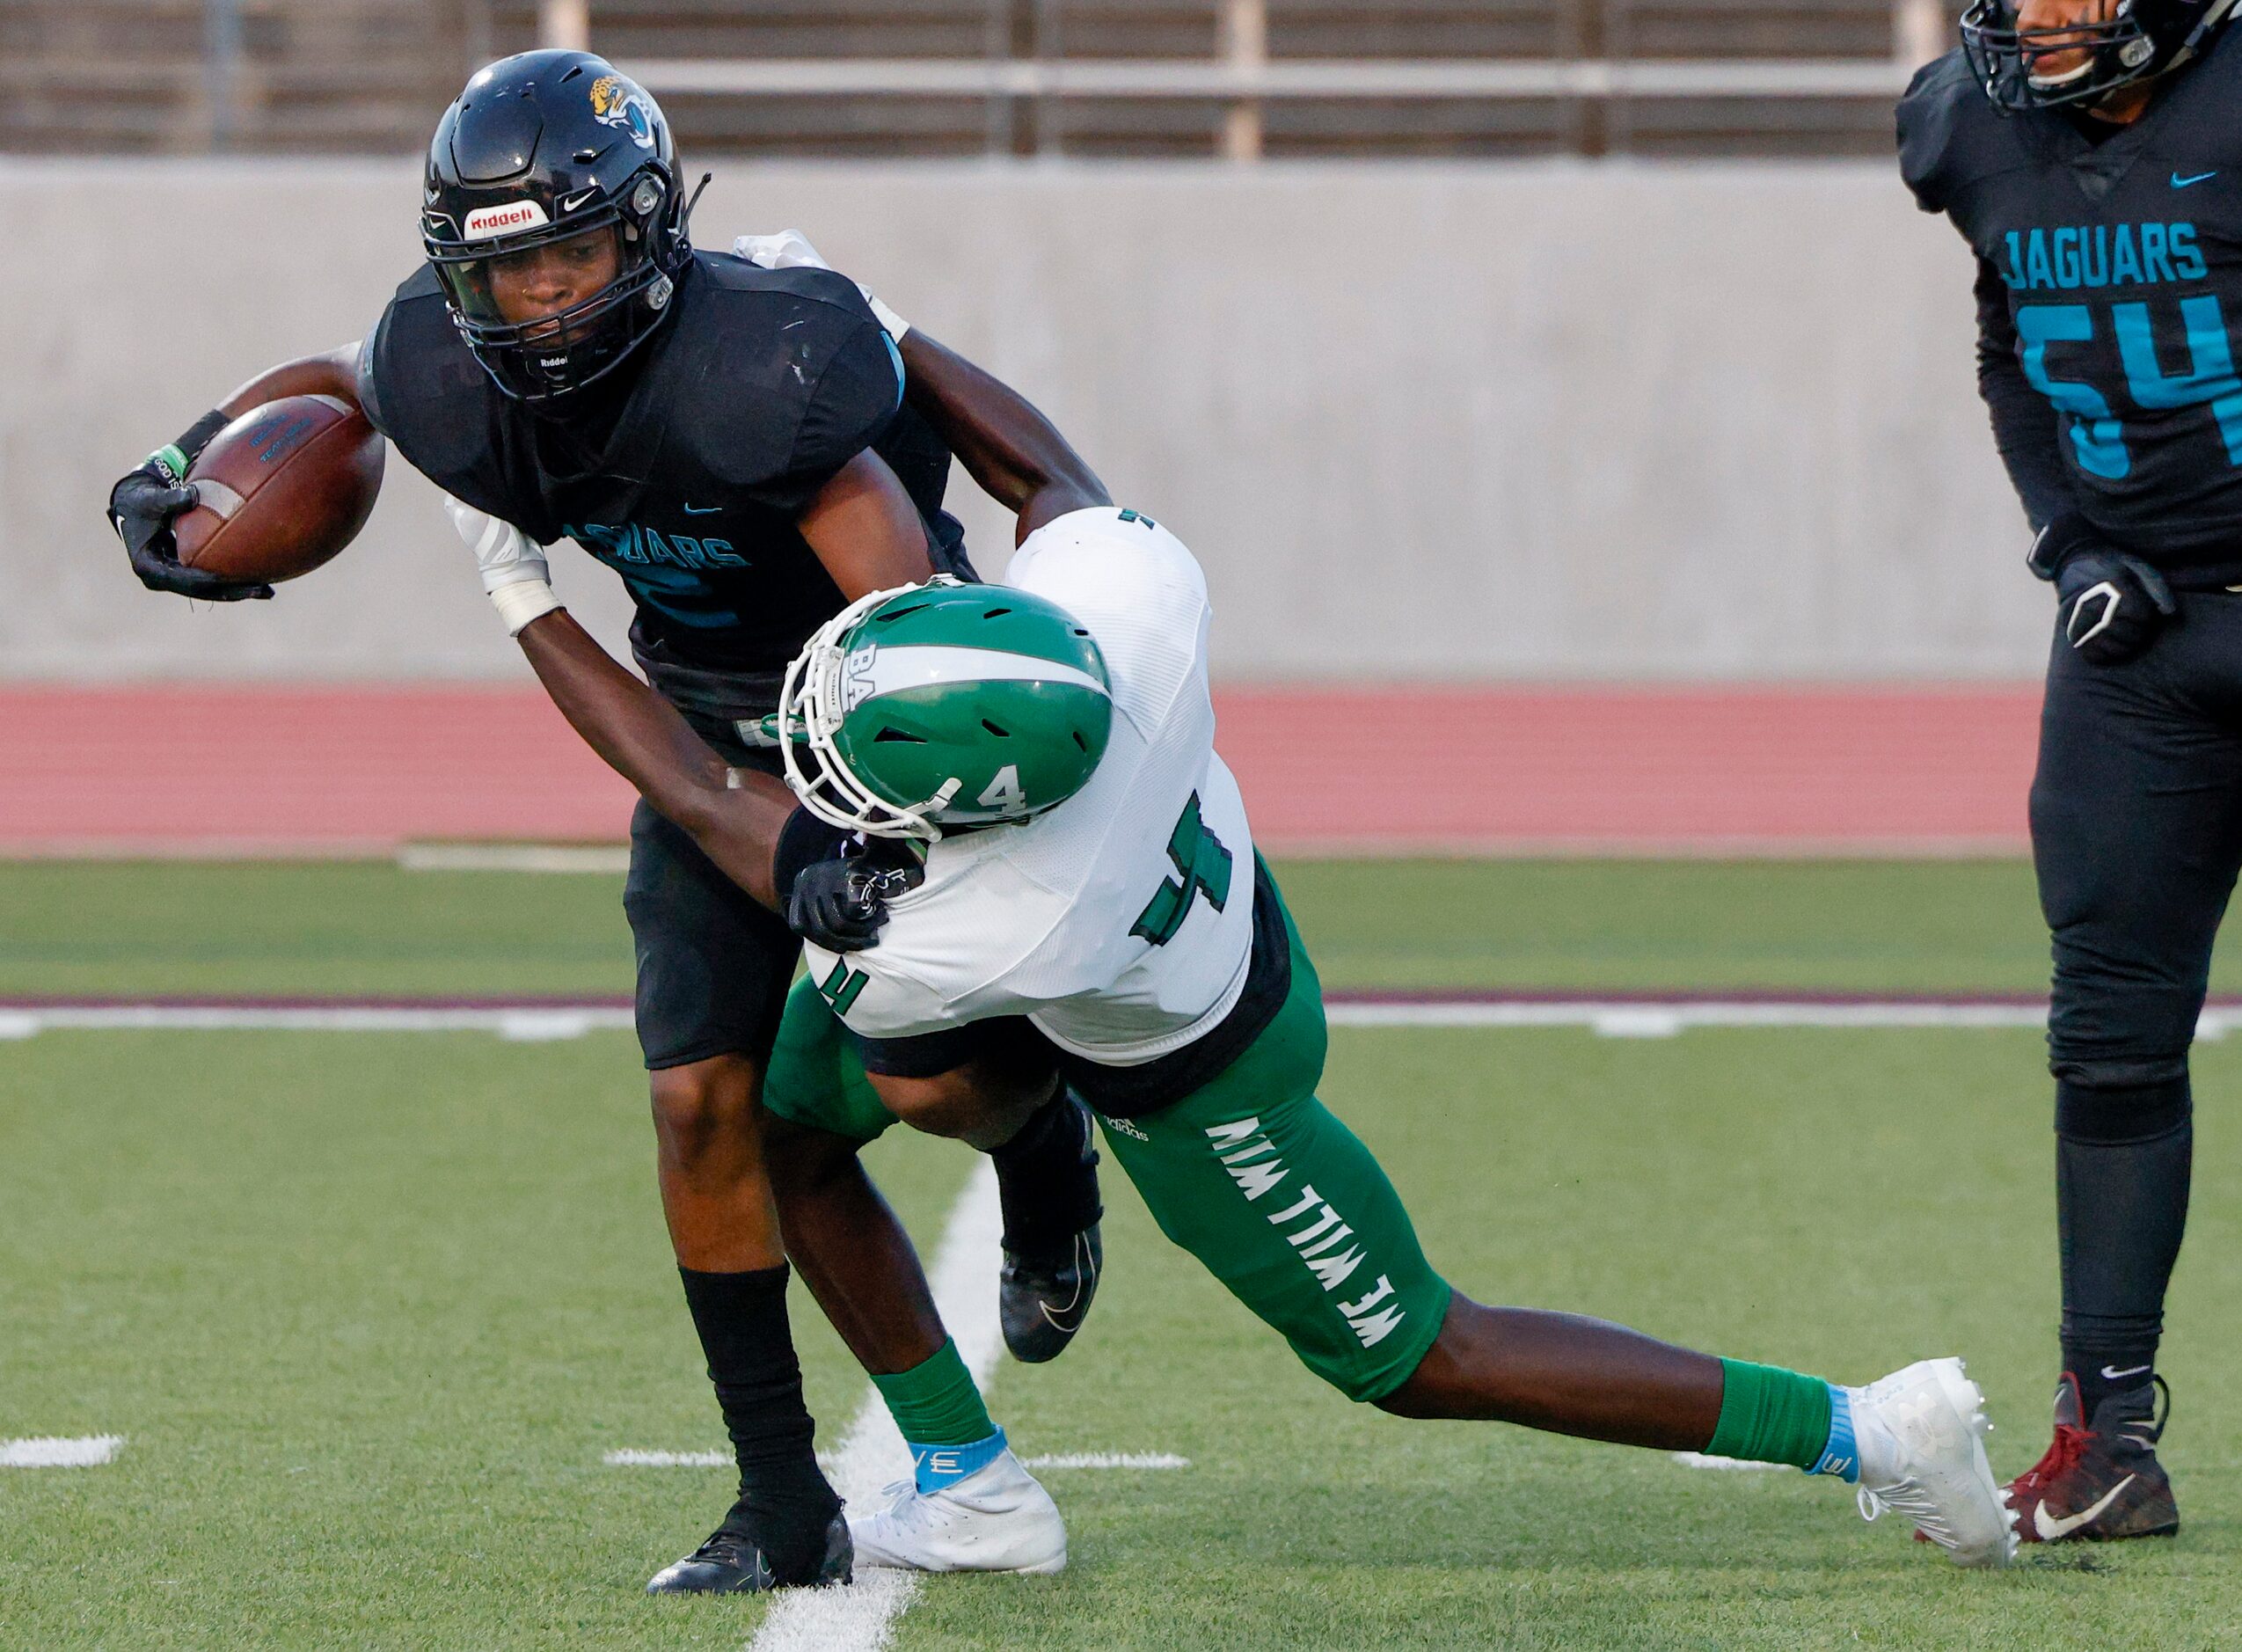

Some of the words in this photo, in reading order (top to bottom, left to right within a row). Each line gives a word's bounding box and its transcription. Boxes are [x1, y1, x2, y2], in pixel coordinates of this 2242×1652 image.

[471, 208, 533, 230] Riddell
[2001, 222, 2209, 290] JAGUARS
[2016, 295, 2242, 479] 54
[154, 458, 172, 479] GOD
[168, 478, 179, 490] IS
[847, 643, 876, 712] BA
[976, 764, 1027, 817] 4
[1128, 788, 1232, 947] 4
[1205, 1116, 1290, 1202] WIN
[1267, 1183, 1368, 1291] WILL
[1336, 1274, 1406, 1349] WE
